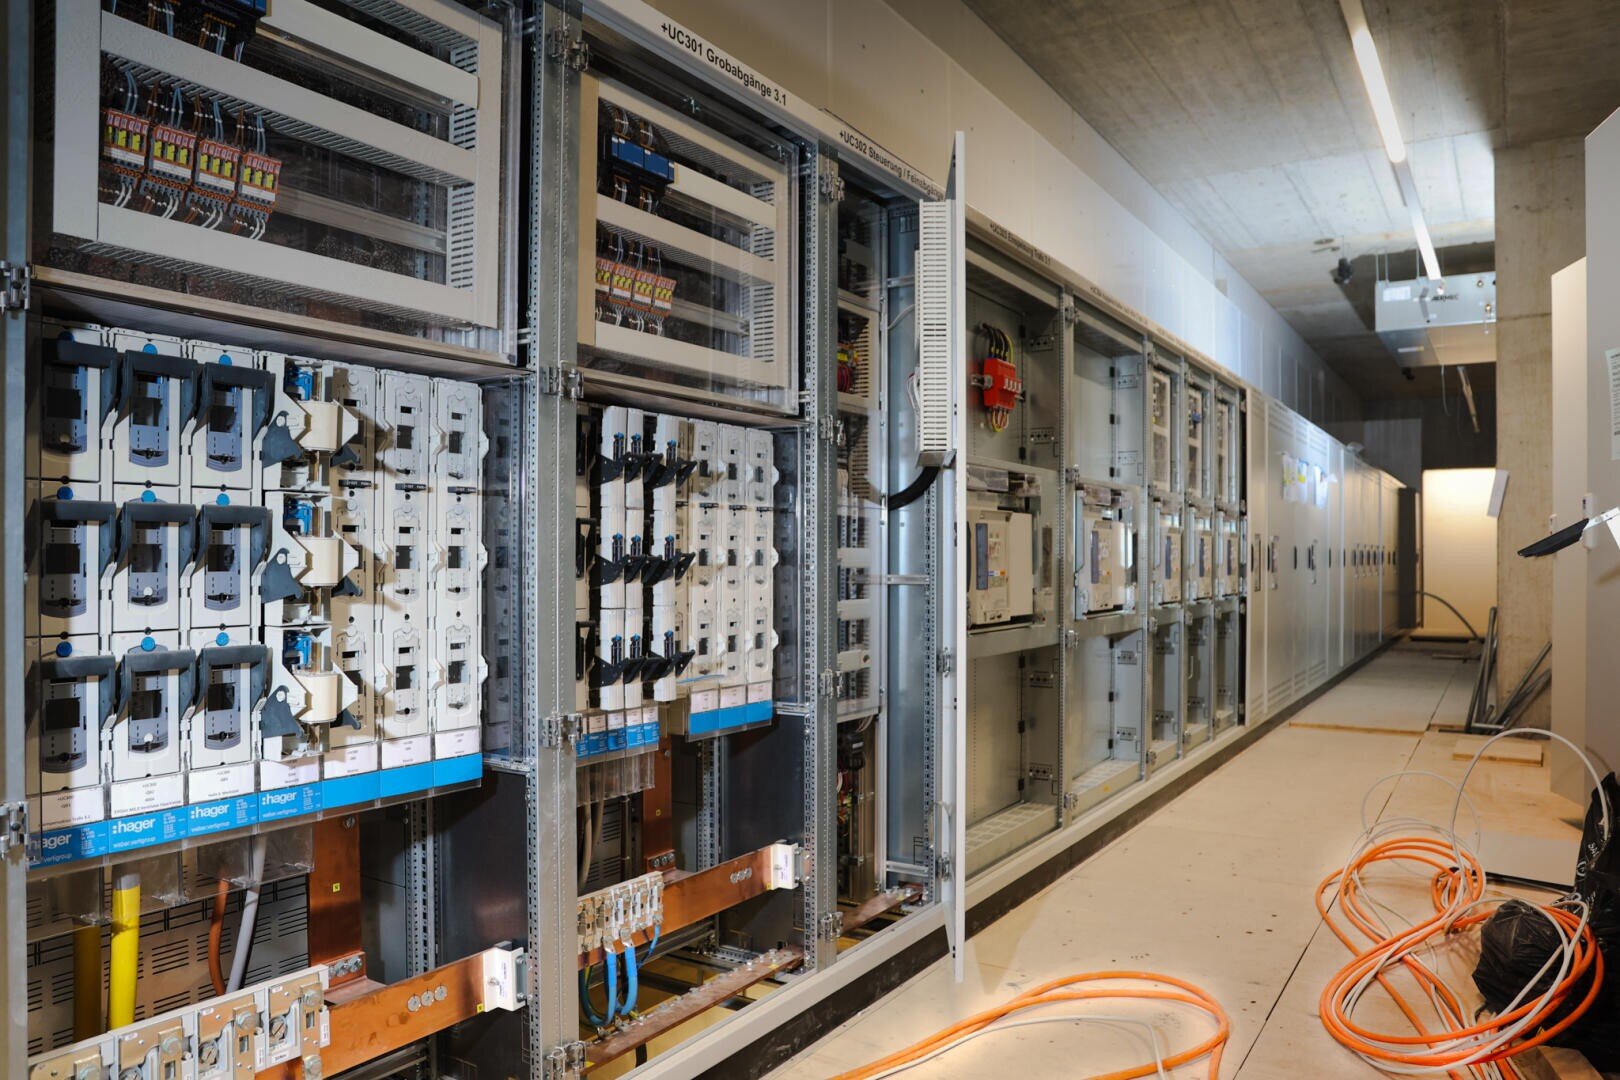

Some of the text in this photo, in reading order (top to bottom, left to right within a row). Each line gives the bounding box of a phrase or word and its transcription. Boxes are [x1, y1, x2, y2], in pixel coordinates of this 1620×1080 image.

[661, 23, 787, 106] +UC301 Grobabgänge 3.1
[839, 130, 868, 154] +UC302
[868, 146, 902, 178] Steuerung
